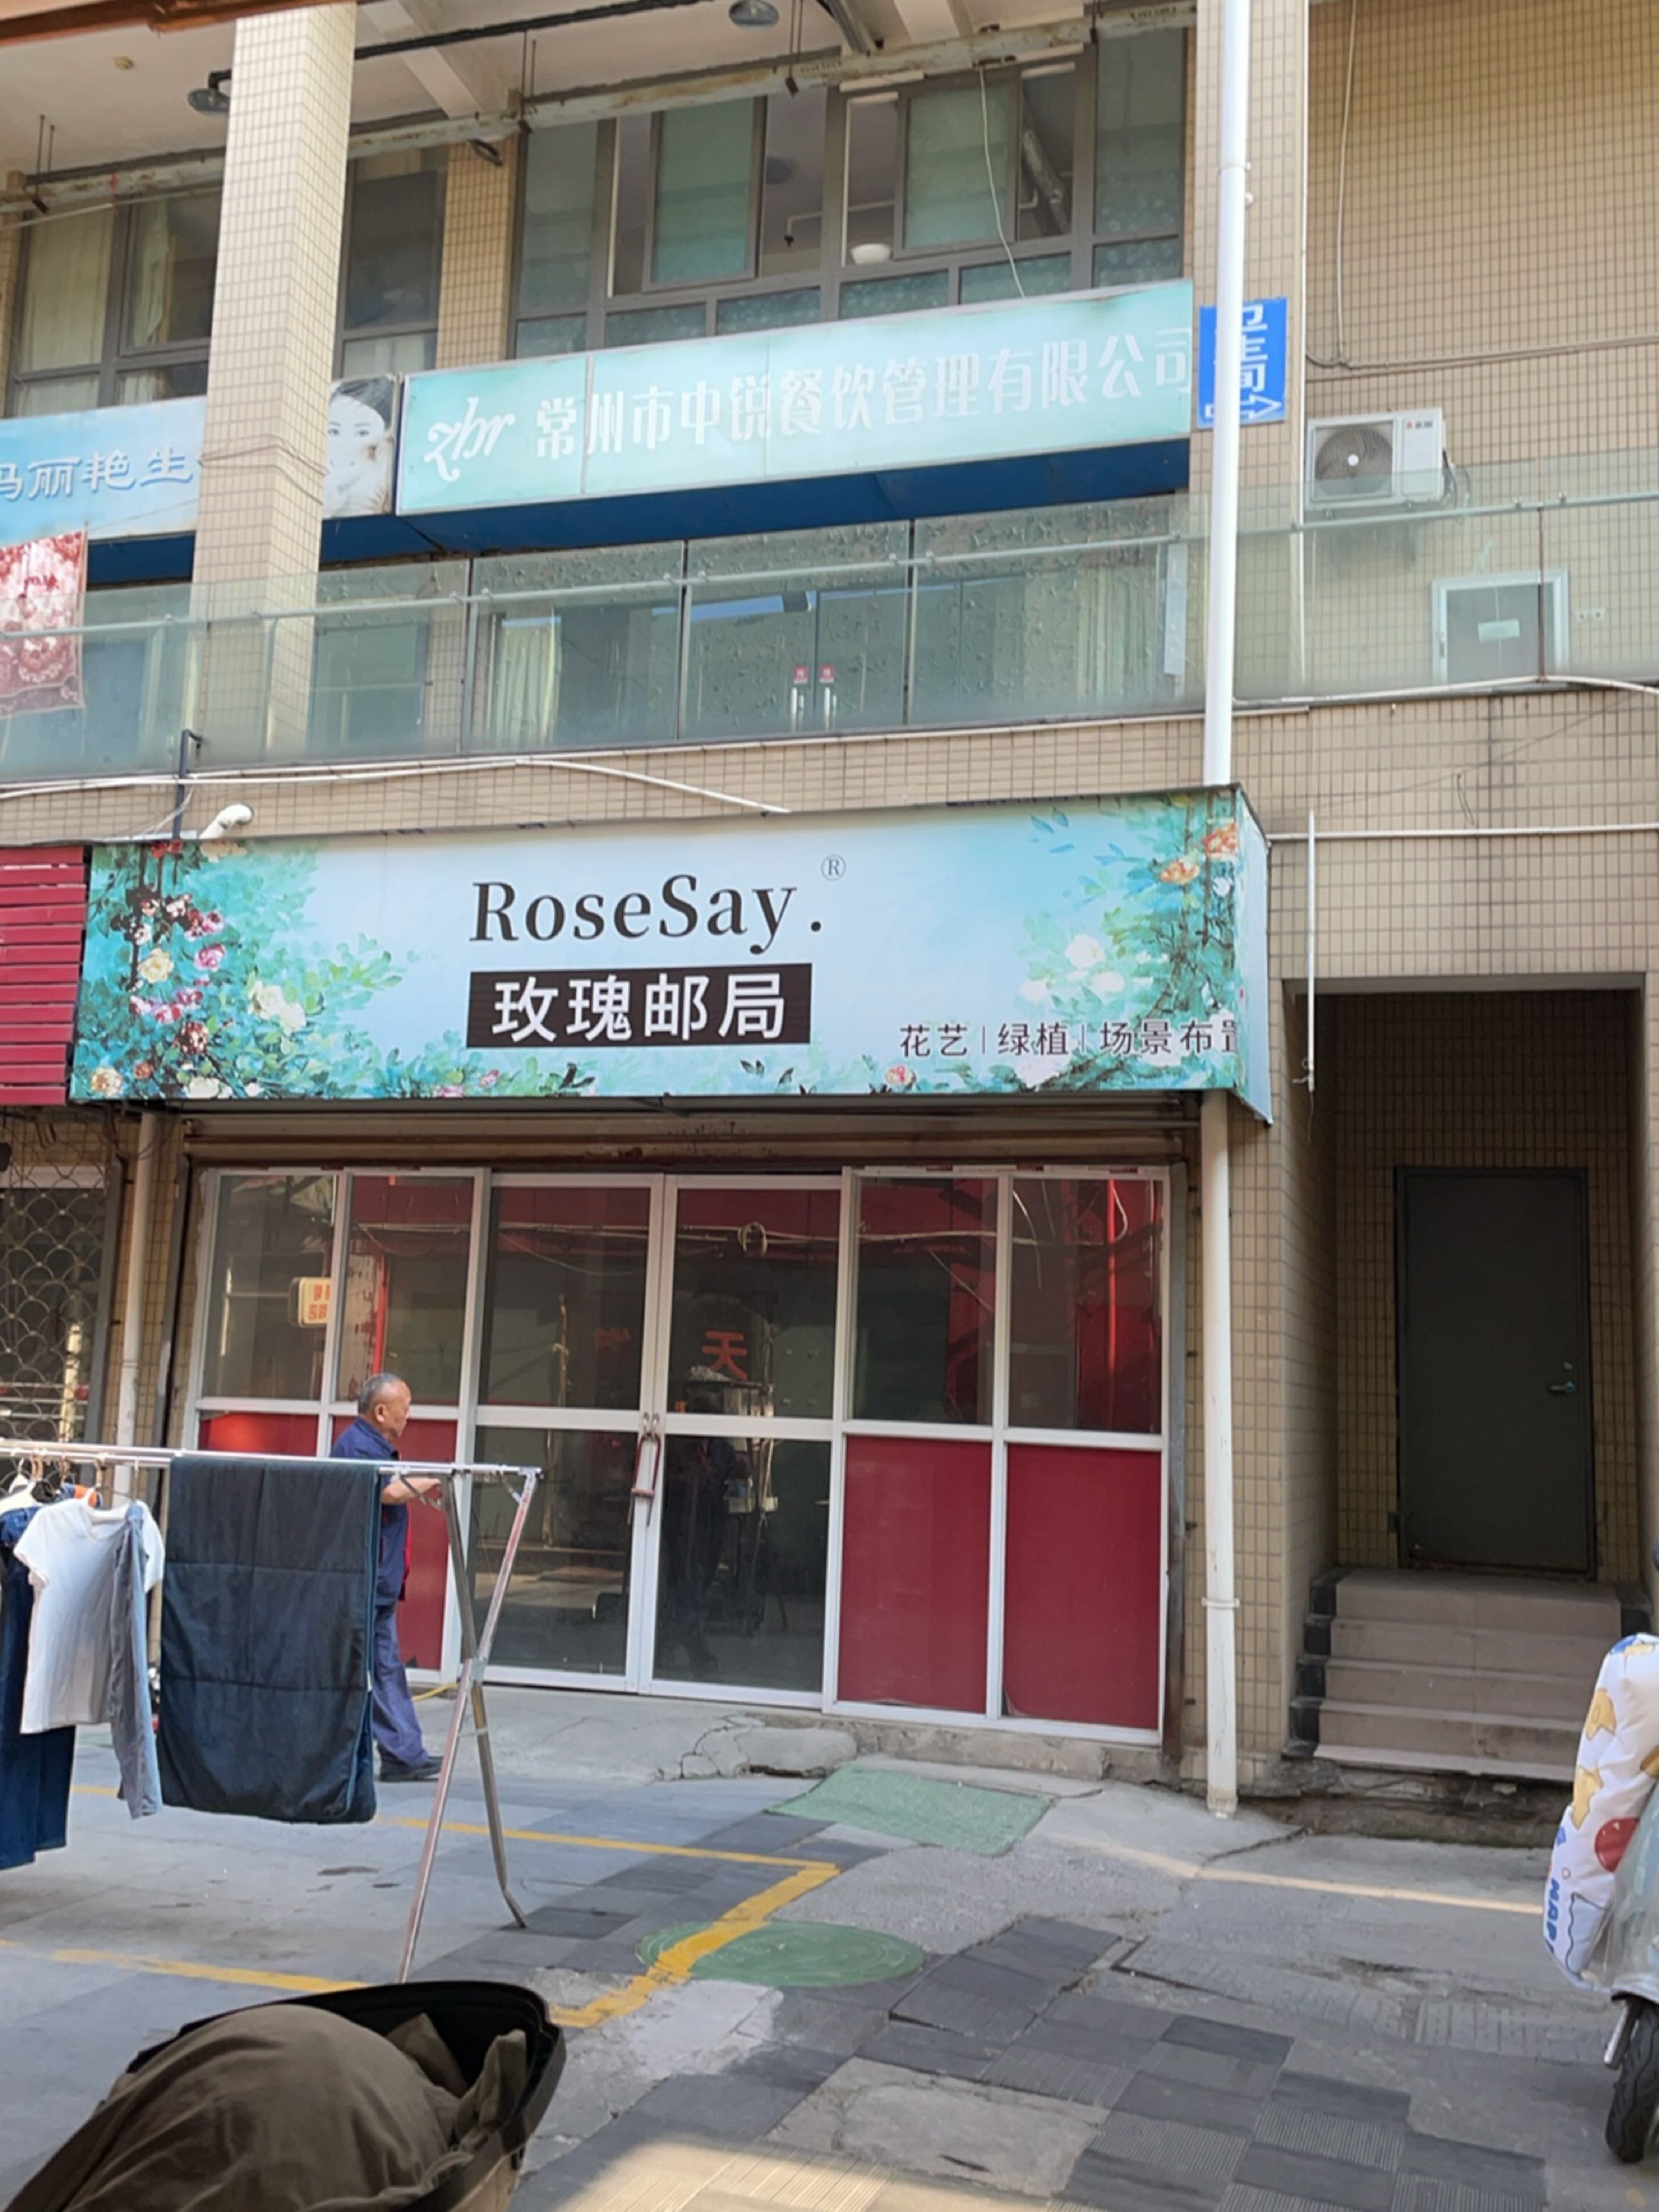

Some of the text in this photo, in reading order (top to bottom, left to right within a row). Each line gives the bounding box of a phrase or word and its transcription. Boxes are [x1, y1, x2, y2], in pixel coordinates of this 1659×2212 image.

[491, 972, 786, 1043] 玫瑰邮局
[899, 1023, 968, 1057] 花艺
[997, 1022, 1070, 1056] 绿植
